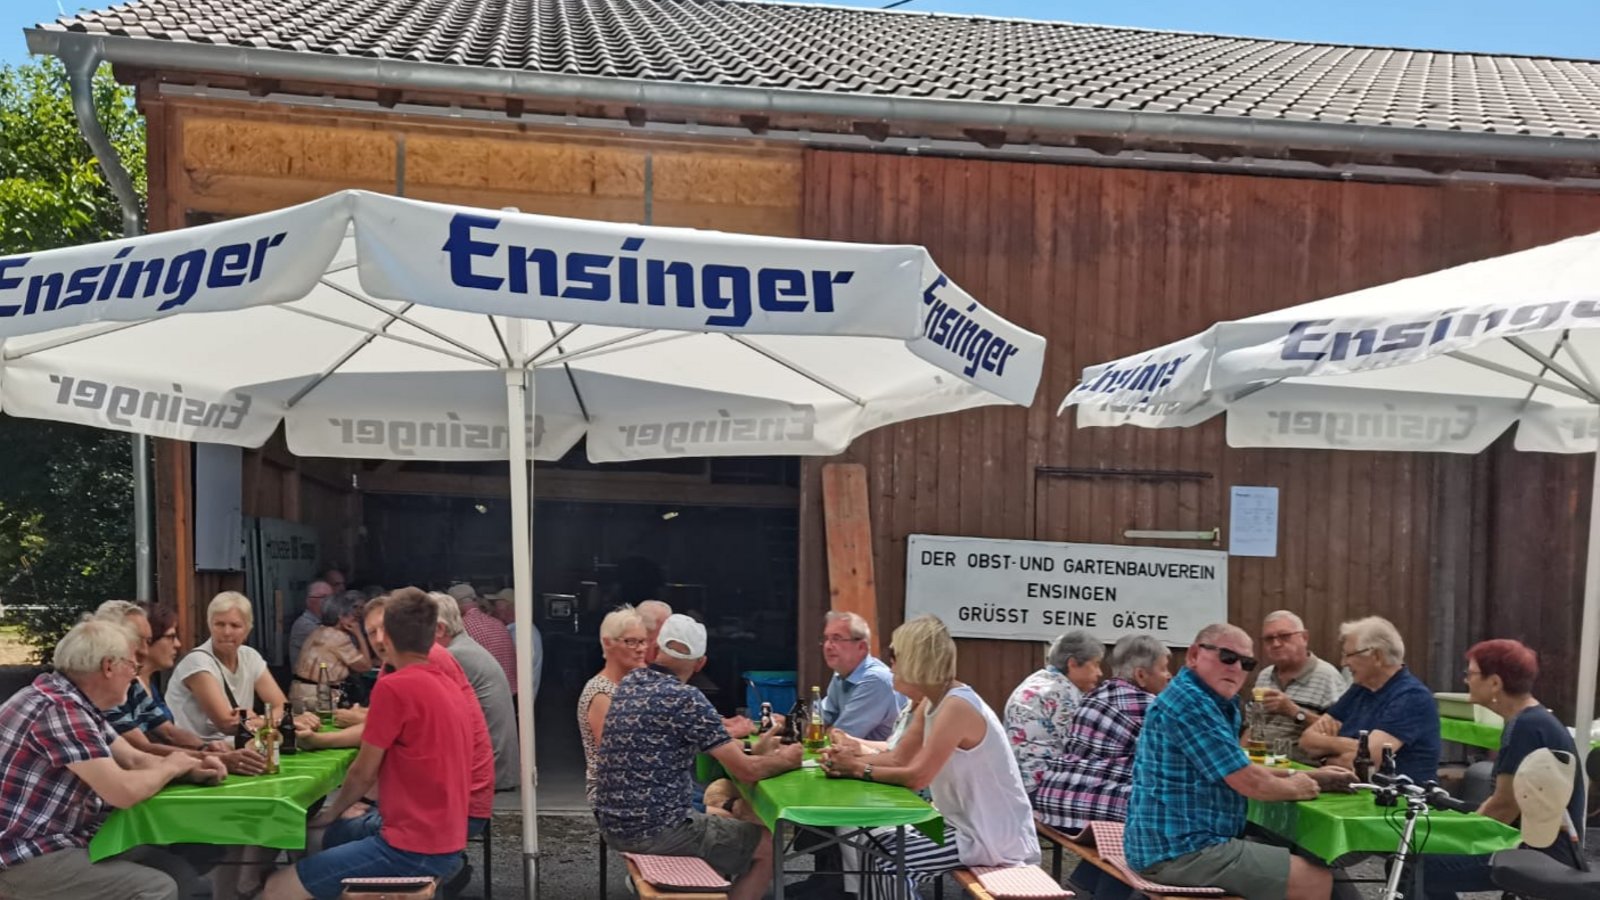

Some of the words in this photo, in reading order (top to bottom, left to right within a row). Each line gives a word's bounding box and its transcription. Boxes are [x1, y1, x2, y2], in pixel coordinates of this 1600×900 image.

[0, 231, 287, 317] Ensinger
[442, 212, 854, 327] Ensinger
[921, 550, 956, 567] DER
[1063, 558, 1216, 580] GARTENBAUVEREIN
[1027, 582, 1117, 602] ENSINGEN
[958, 603, 1029, 624] GRÜSST
[1042, 610, 1097, 628] SEINE
[1112, 610, 1169, 631] GÄSTE
